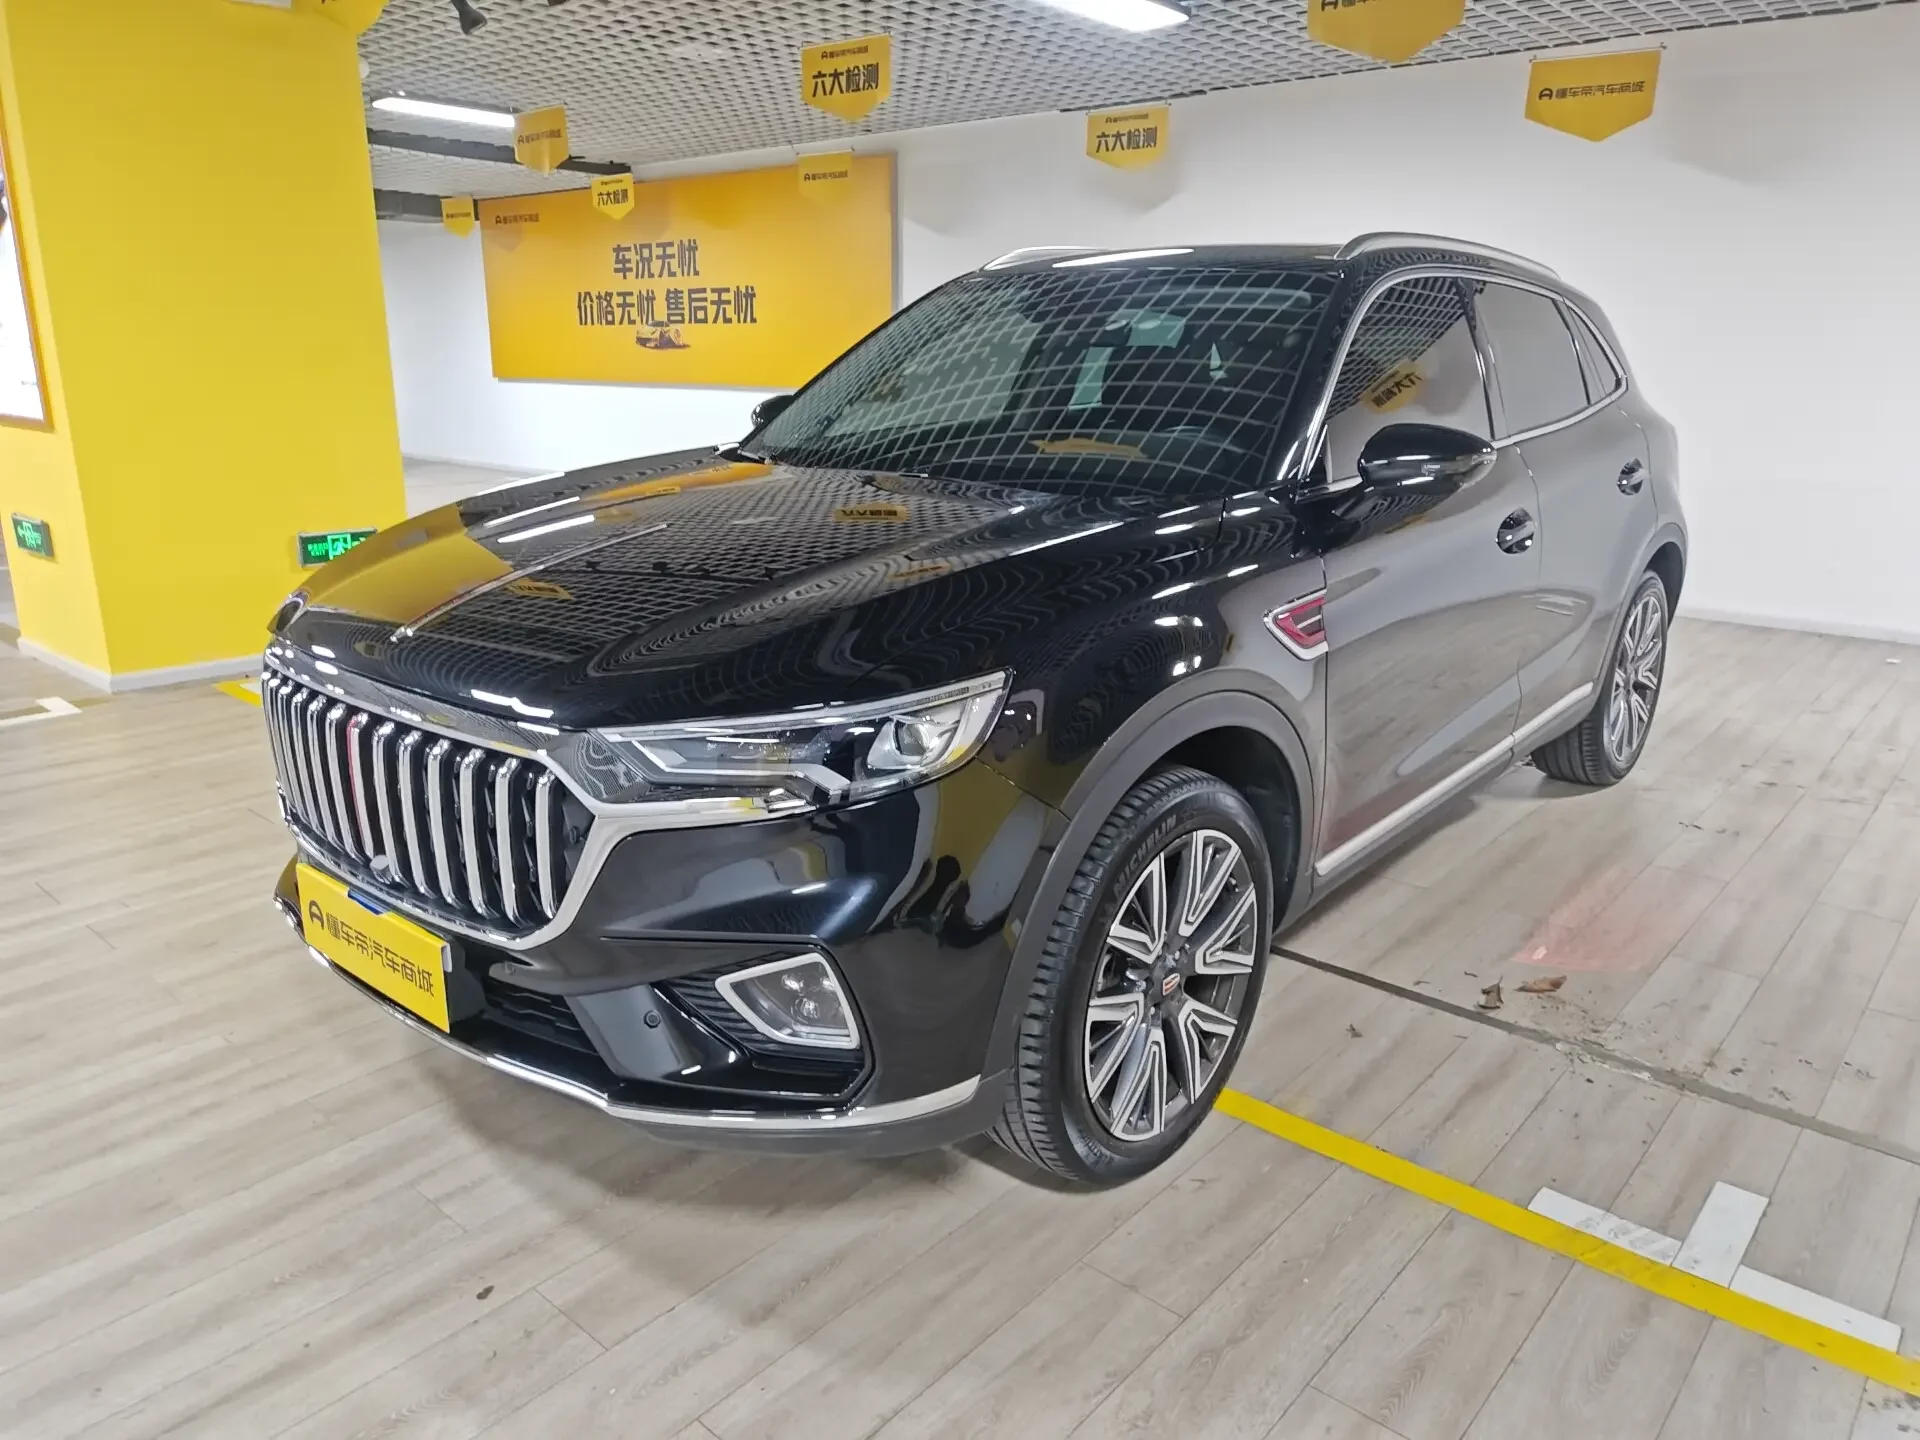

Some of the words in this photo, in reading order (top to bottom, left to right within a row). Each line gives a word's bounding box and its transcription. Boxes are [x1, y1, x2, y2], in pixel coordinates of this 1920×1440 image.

[812, 62, 879, 98] 六大检测
[1096, 126, 1158, 153] 六大检测
[597, 188, 629, 206] 六大检测
[612, 239, 700, 280] 车况无忧
[577, 289, 656, 325] 价格无忧
[665, 285, 757, 324] 售后无忧
[1113, 813, 1177, 900] MICHELIN
[325, 911, 435, 997] 懂车帝汽车商城
